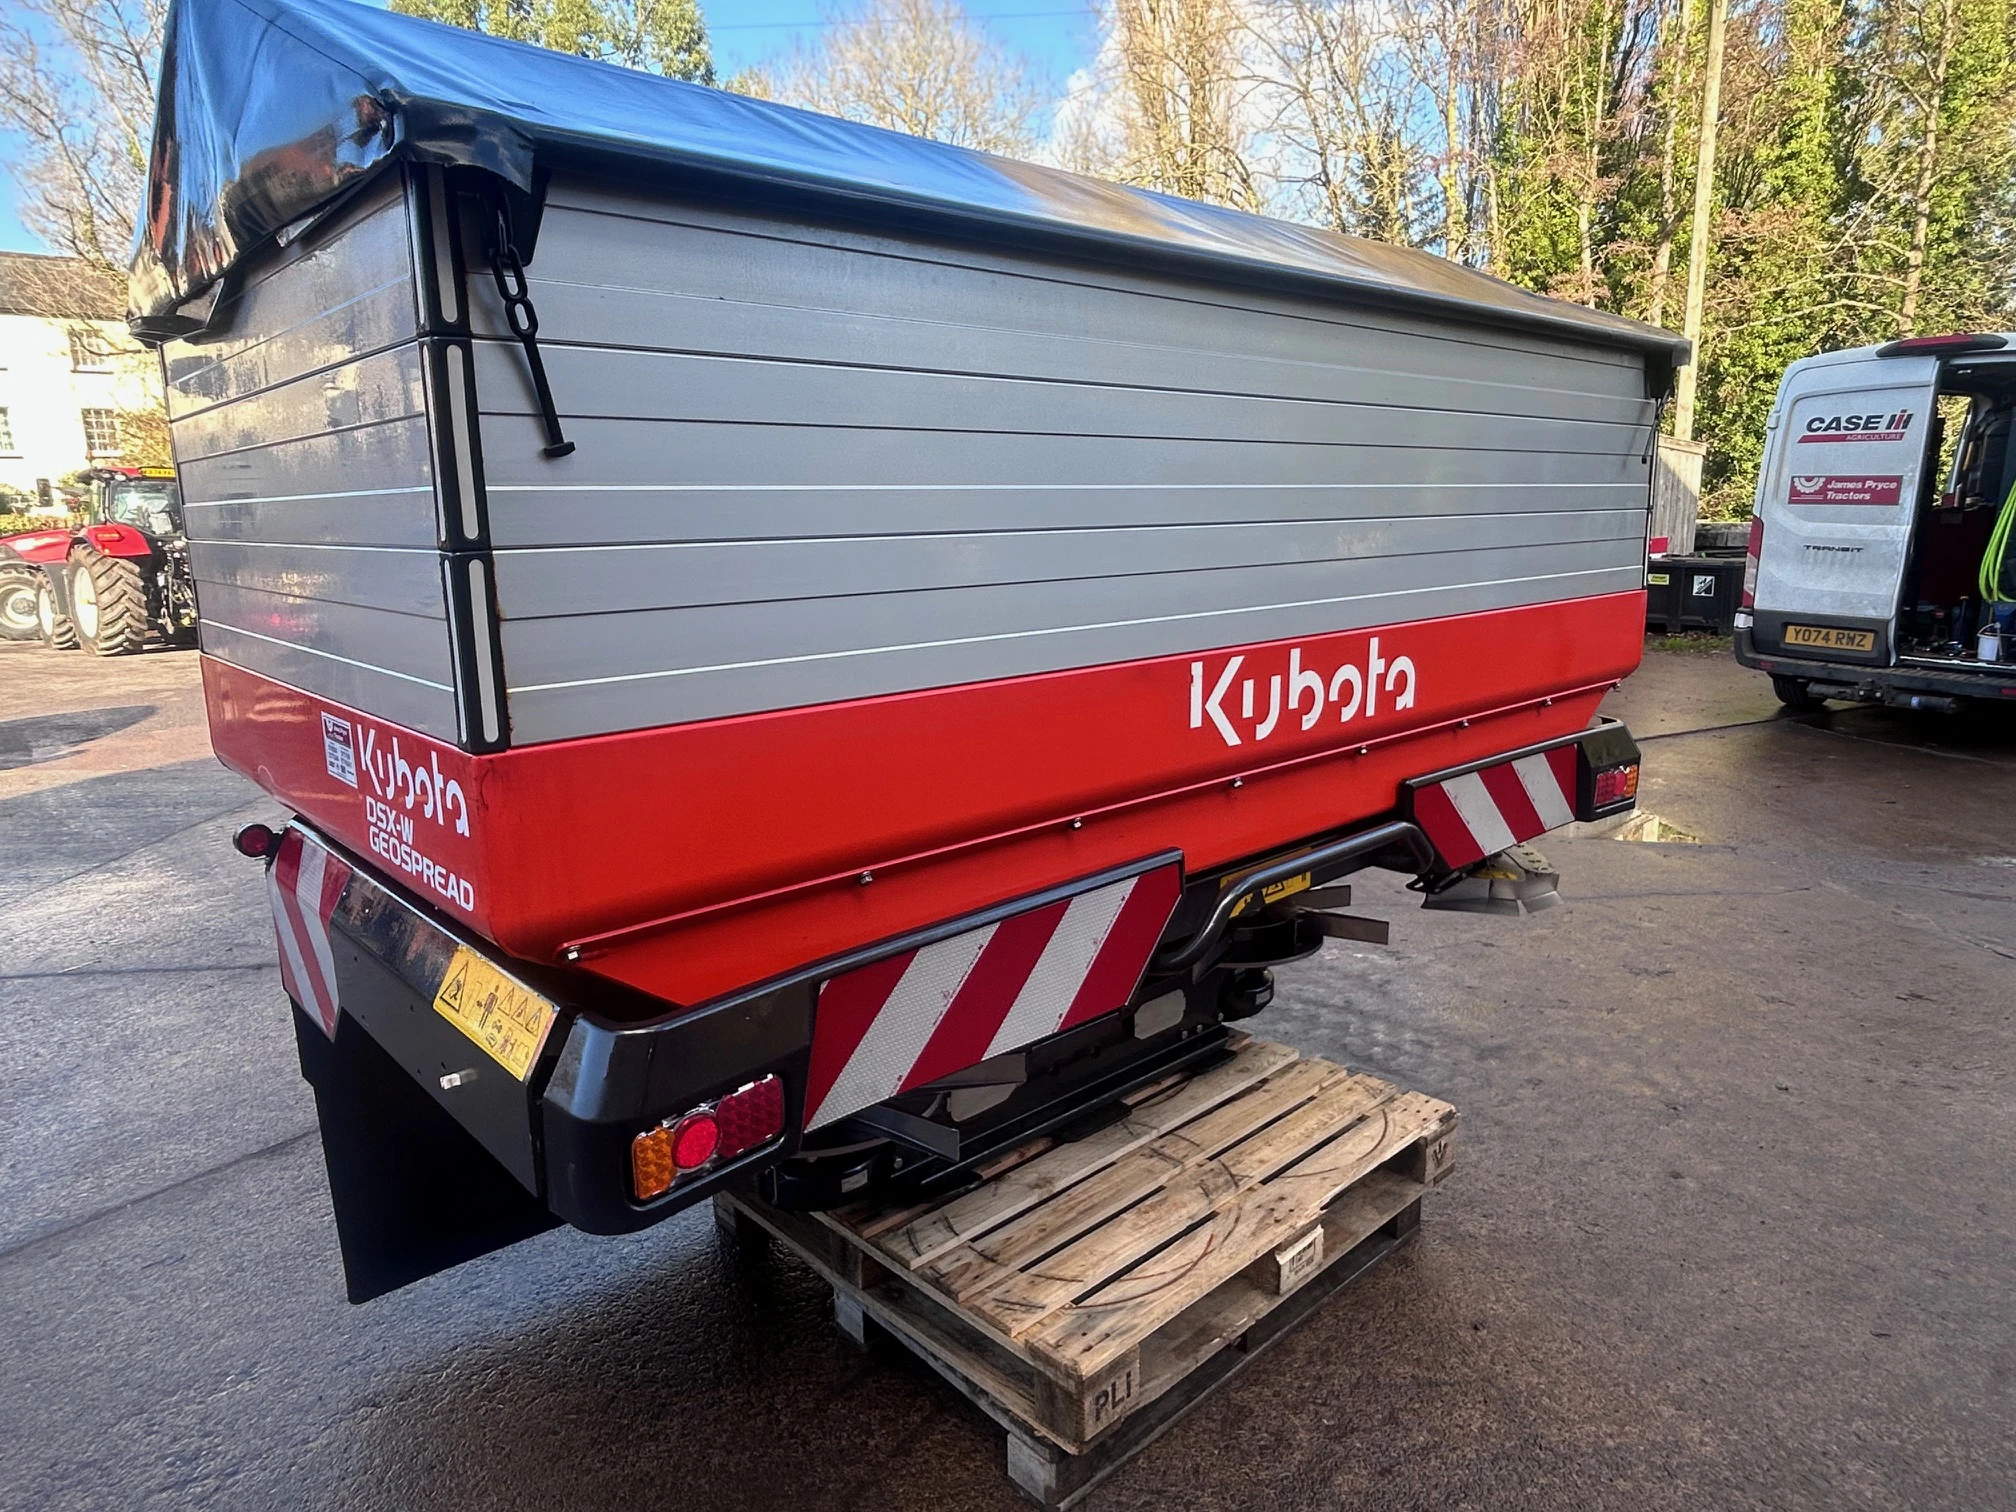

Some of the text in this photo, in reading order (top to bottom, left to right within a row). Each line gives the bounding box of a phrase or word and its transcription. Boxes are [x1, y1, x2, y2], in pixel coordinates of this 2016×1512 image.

[1805, 414, 1885, 433] CASE
[1845, 433, 1902, 441] AGRICULTURE
[1826, 480, 1898, 491] James Pryce
[1826, 490, 1872, 500] Tractors
[1803, 544, 1864, 553] TRANSIT
[1834, 631, 1868, 648] RWZ
[1189, 636, 1416, 747] Kubota
[356, 723, 471, 838] Kubota
[365, 795, 414, 846] DSX-W
[369, 825, 475, 912] GEOSPREAD
